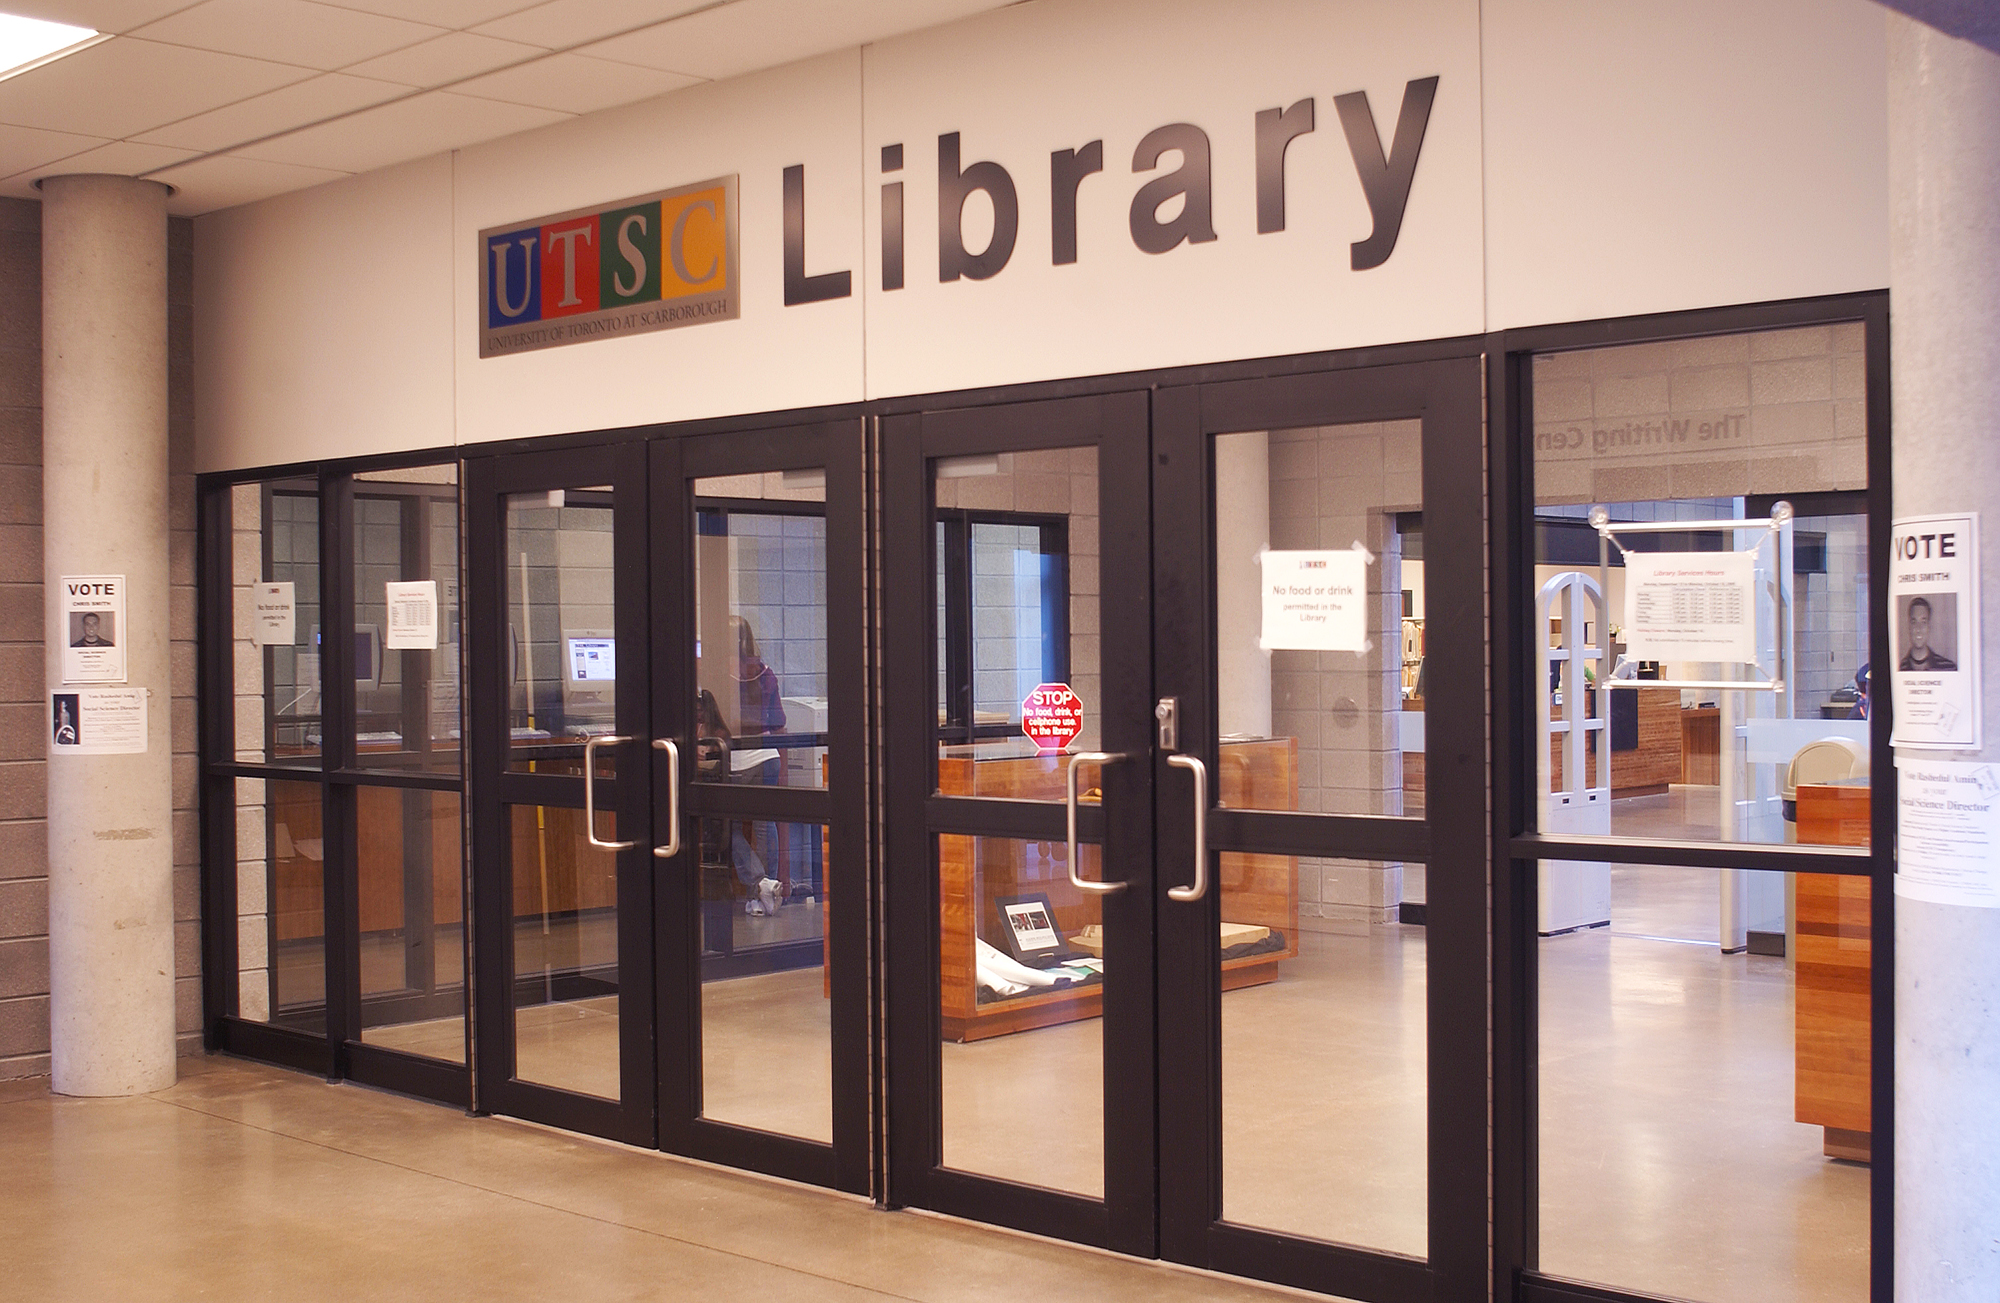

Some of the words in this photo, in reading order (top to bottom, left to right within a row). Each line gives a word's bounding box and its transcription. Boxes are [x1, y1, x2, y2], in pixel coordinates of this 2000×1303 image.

[782, 75, 1440, 308] Library
[491, 200, 718, 318] UTSC
[488, 329, 550, 351] UNIVERSITY
[551, 327, 565, 342] OF
[568, 317, 622, 339] TORONTO
[623, 314, 639, 331] AT
[641, 299, 728, 327] SCARBOROUGH
[1894, 532, 1956, 561] VOTE
[1653, 570, 1676, 578] Library
[1898, 573, 1916, 583] CHRIS
[1919, 572, 1950, 582] SMITH
[68, 583, 115, 596] VOTE
[1272, 585, 1286, 596] No
[1289, 585, 1312, 596] food
[1314, 587, 1325, 596] or
[1327, 585, 1353, 596] drink
[1283, 603, 1319, 612] permitted
[1321, 603, 1328, 611] in
[1330, 603, 1342, 611] the
[1300, 613, 1326, 623] Library
[1032, 690, 1073, 706] STOP
[1023, 707, 1034, 716] No
[1035, 707, 1053, 717] food,
[1054, 707, 1073, 717] drink,
[1028, 717, 1061, 727] cellphone
[1031, 726, 1038, 735] in
[1039, 726, 1051, 735] the
[1946, 799, 1991, 812] Director
